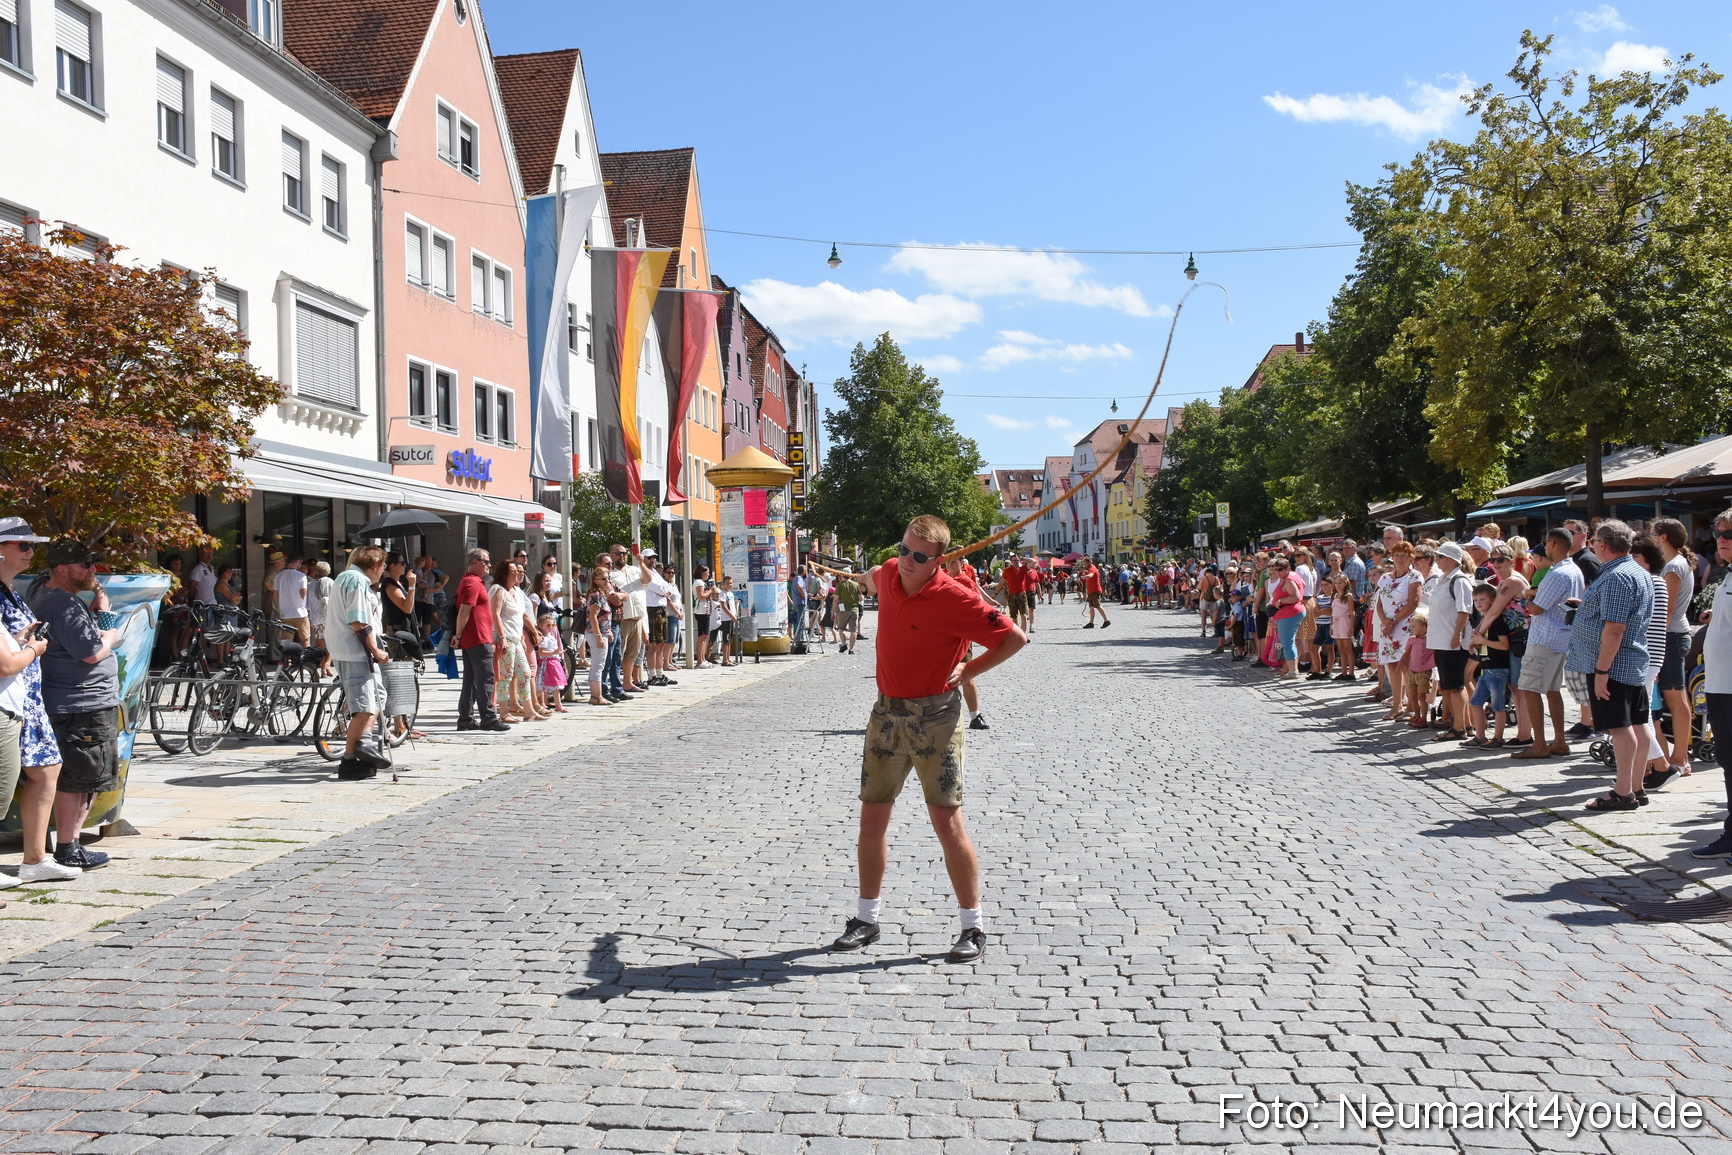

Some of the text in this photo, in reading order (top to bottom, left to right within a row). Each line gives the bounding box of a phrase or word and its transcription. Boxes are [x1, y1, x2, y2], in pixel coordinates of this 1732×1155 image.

[392, 448, 433, 461] sutor.
[448, 447, 492, 482] sutor.
[789, 433, 804, 511] HOTEL
